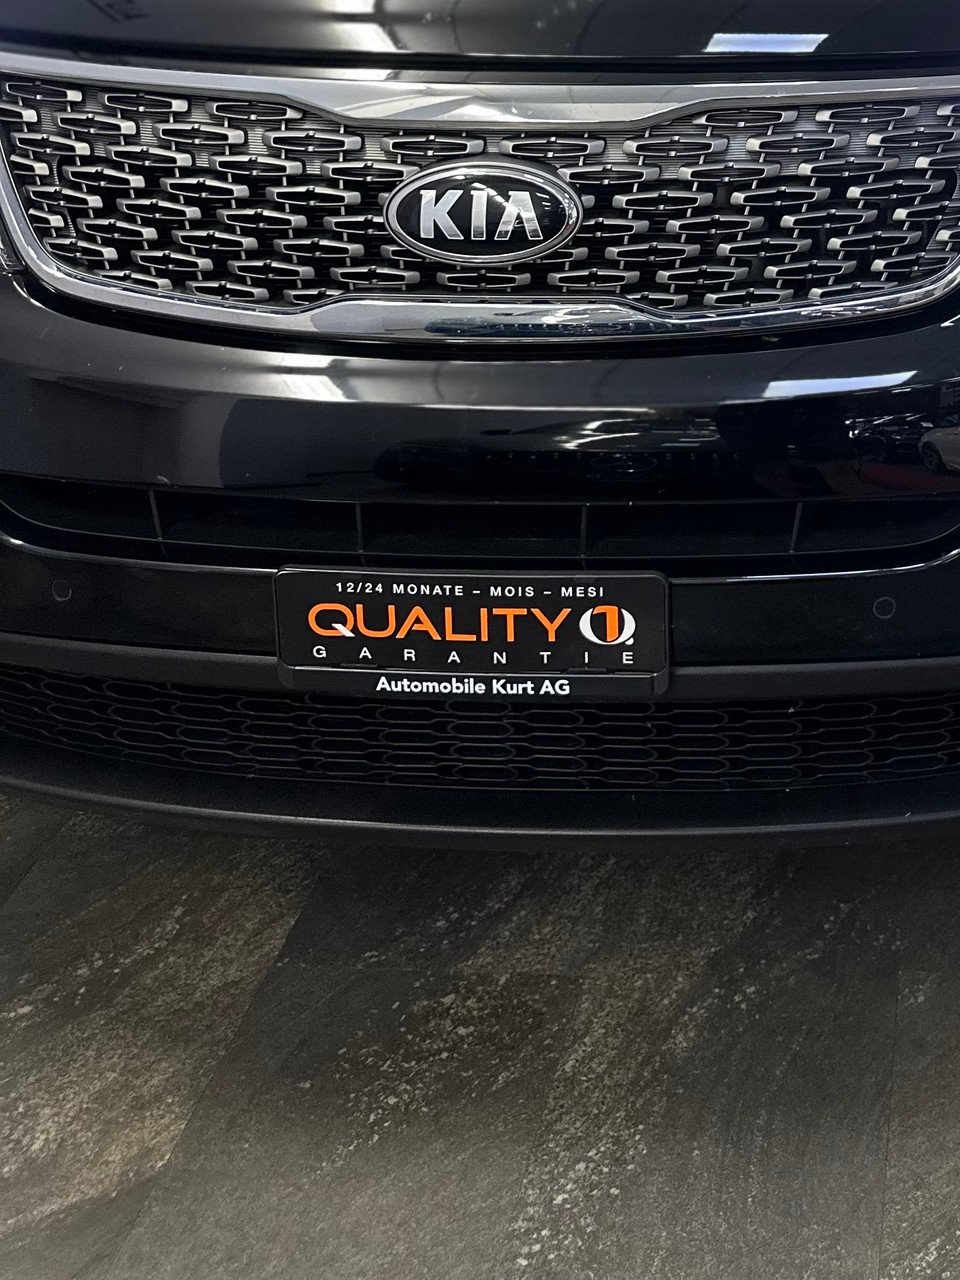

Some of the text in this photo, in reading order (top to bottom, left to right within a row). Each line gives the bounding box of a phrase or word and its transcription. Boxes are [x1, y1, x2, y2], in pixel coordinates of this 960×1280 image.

[419, 189, 544, 241] KIA
[335, 582, 383, 594] 12/24
[392, 583, 464, 596] MONATE
[489, 586, 535, 598] MOIS
[561, 586, 604, 598] MESI
[308, 603, 572, 642] QUALITY
[312, 645, 634, 664] GARANTIE
[375, 676, 570, 695] Automobile Kurt AG
